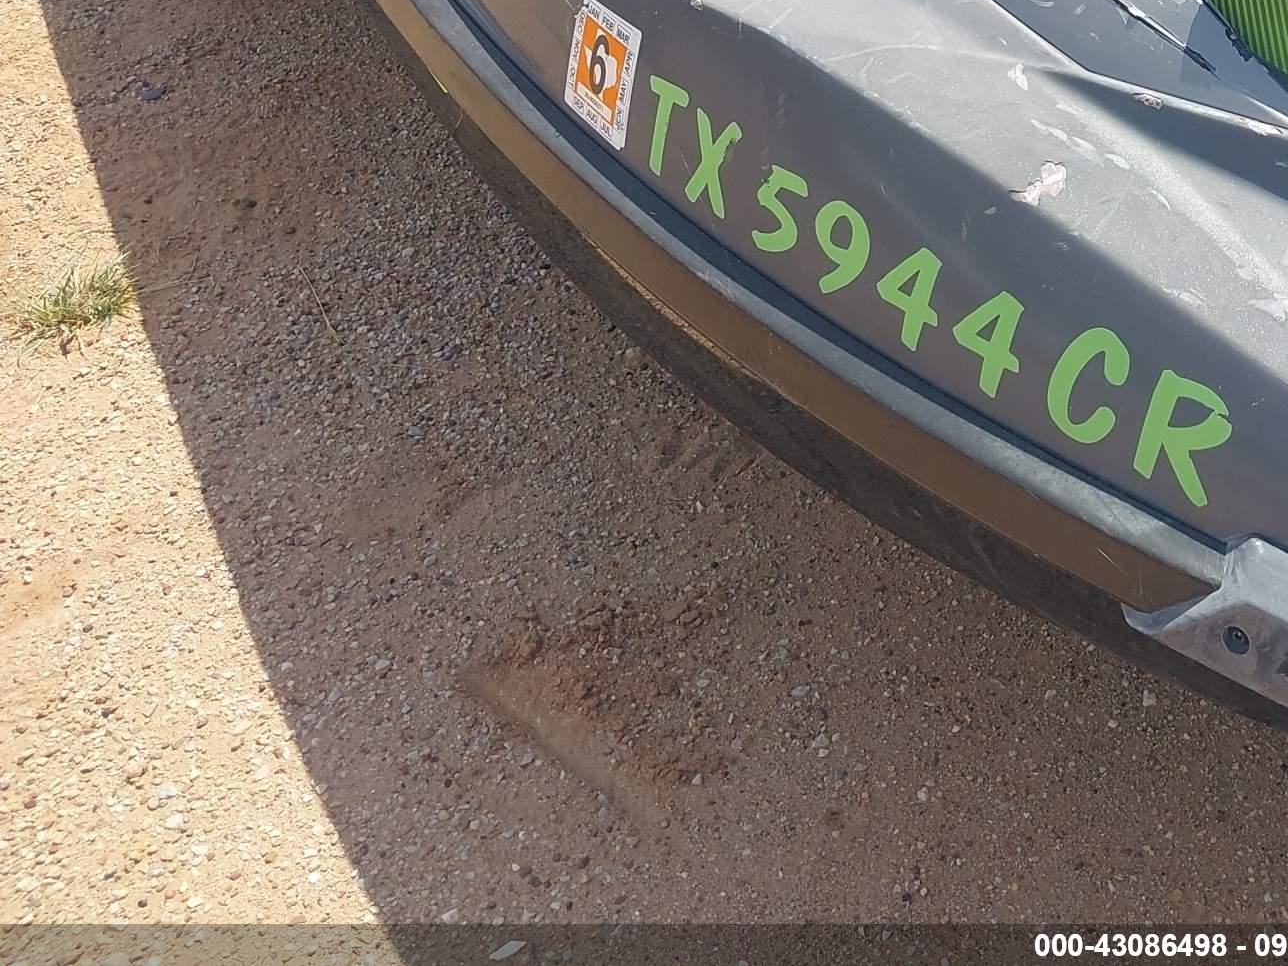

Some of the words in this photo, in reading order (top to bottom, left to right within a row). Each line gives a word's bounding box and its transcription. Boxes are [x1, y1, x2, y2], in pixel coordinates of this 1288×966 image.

[588, 2, 600, 21] JAN
[601, 13, 616, 32] FEB
[616, 25, 631, 44] MAR
[589, 34, 610, 95] 6
[625, 50, 634, 76] APR
[618, 79, 628, 102] MAY
[650, 75, 743, 220] TX
[751, 164, 1025, 400] 5944
[1047, 326, 1233, 508] CR
